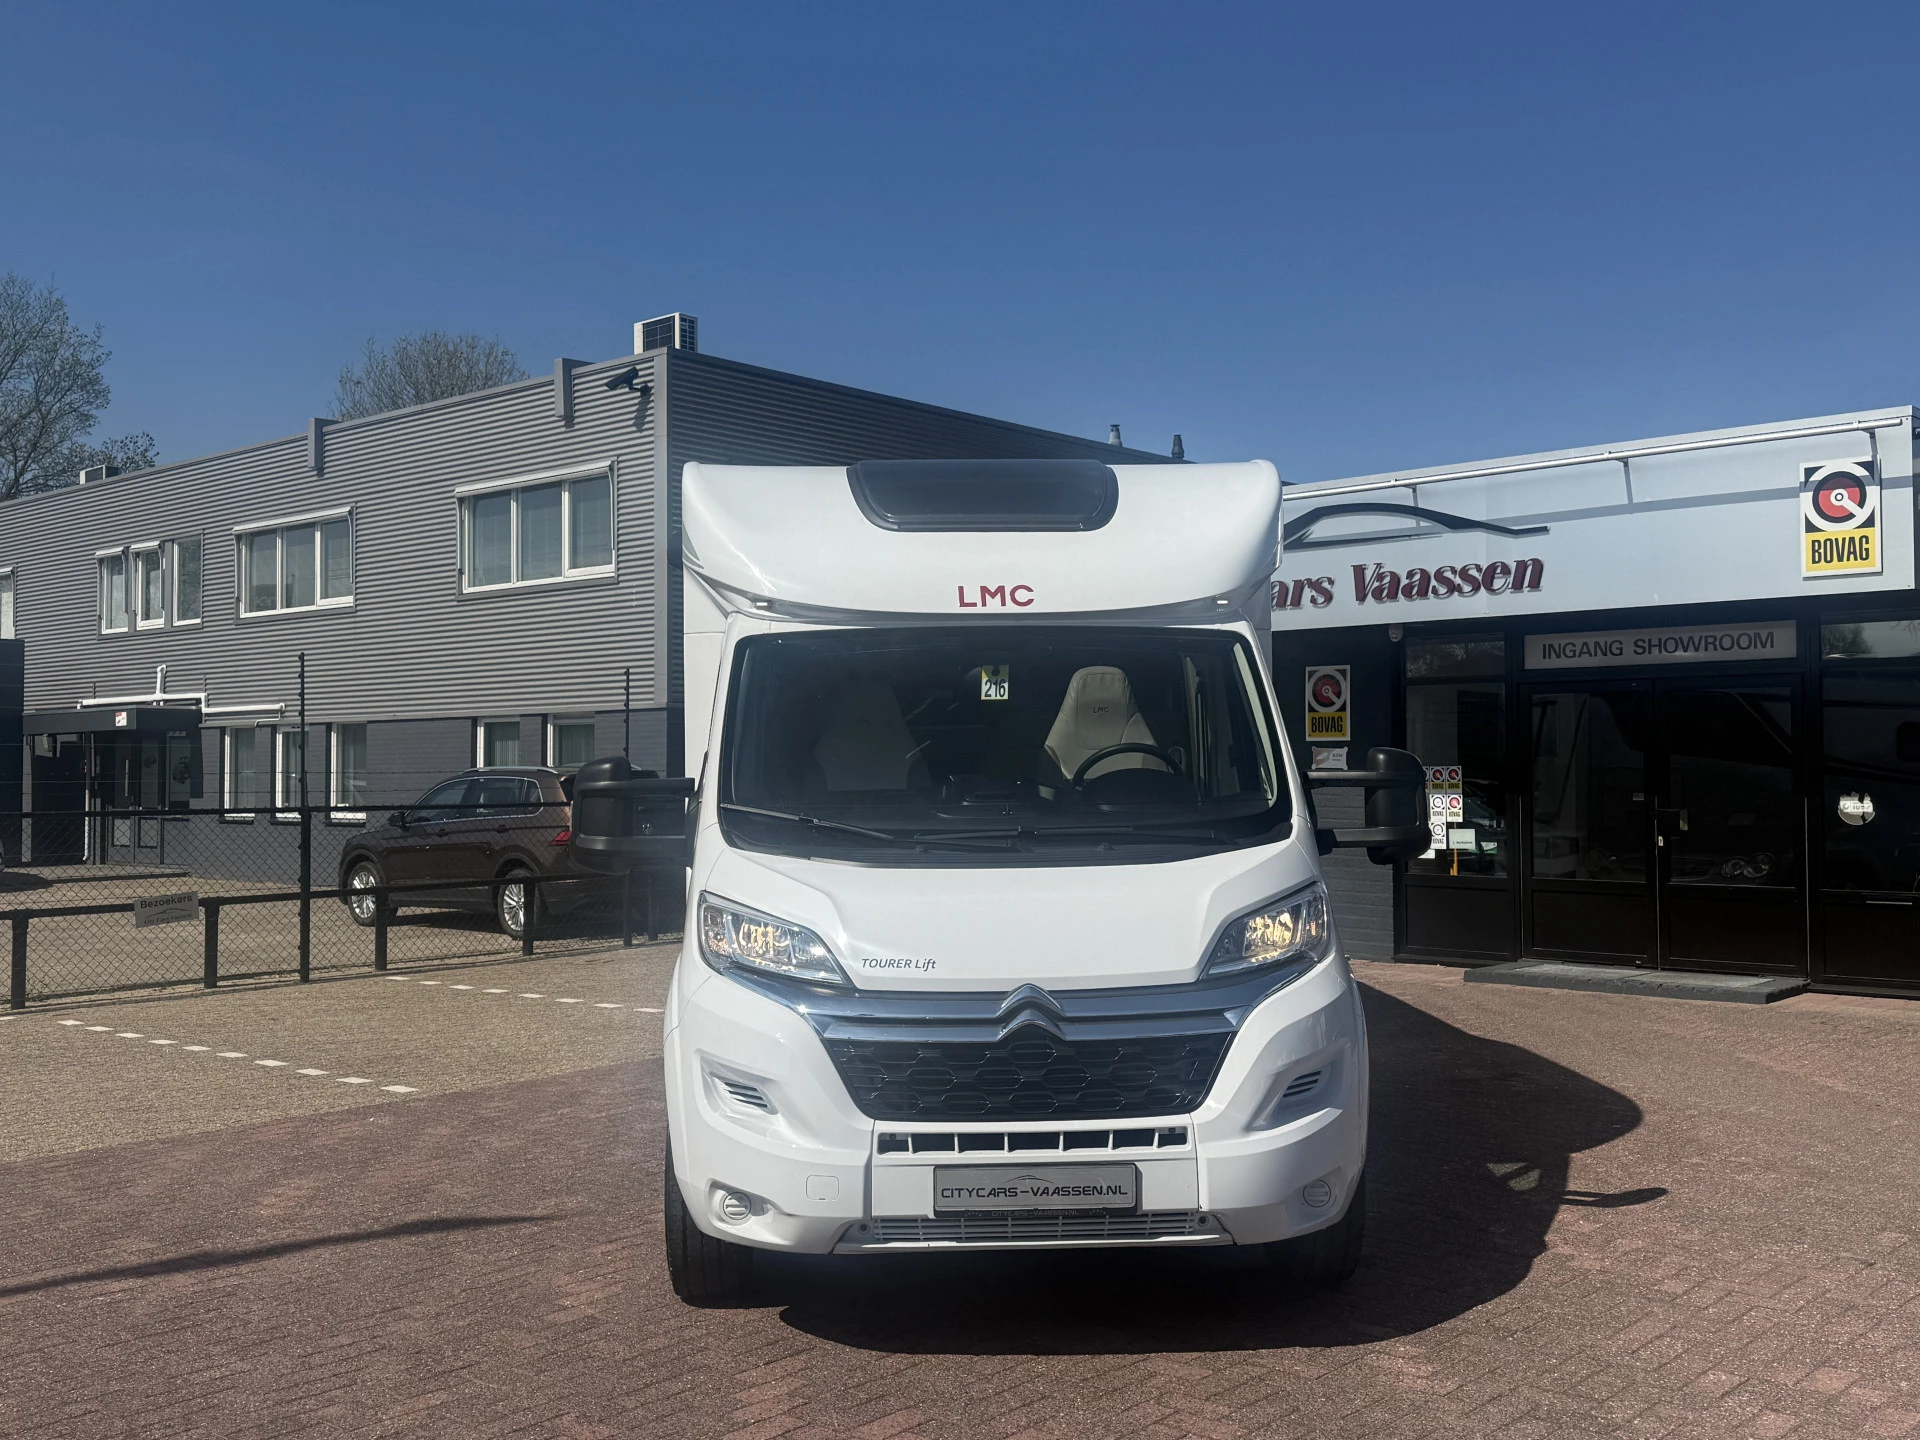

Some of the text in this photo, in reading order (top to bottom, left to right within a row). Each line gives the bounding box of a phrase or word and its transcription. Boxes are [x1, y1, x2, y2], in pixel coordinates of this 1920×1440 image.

[1811, 534, 1870, 565] BOVAG
[1271, 557, 1545, 610] ars Vaassen
[957, 584, 1035, 608] LMC
[1542, 631, 1775, 660] INGANG SHOWROOM
[984, 678, 1006, 698] 216
[1092, 706, 1110, 714] LMC
[1311, 716, 1343, 733] BOVAG
[140, 895, 193, 909] Bezoekers
[861, 958, 937, 972] TOURER Lift
[941, 1185, 1128, 1199] CITYCARS-VAASSEN.NL
[991, 1209, 1079, 1217] CITYCARS-VAASSEN.NL
